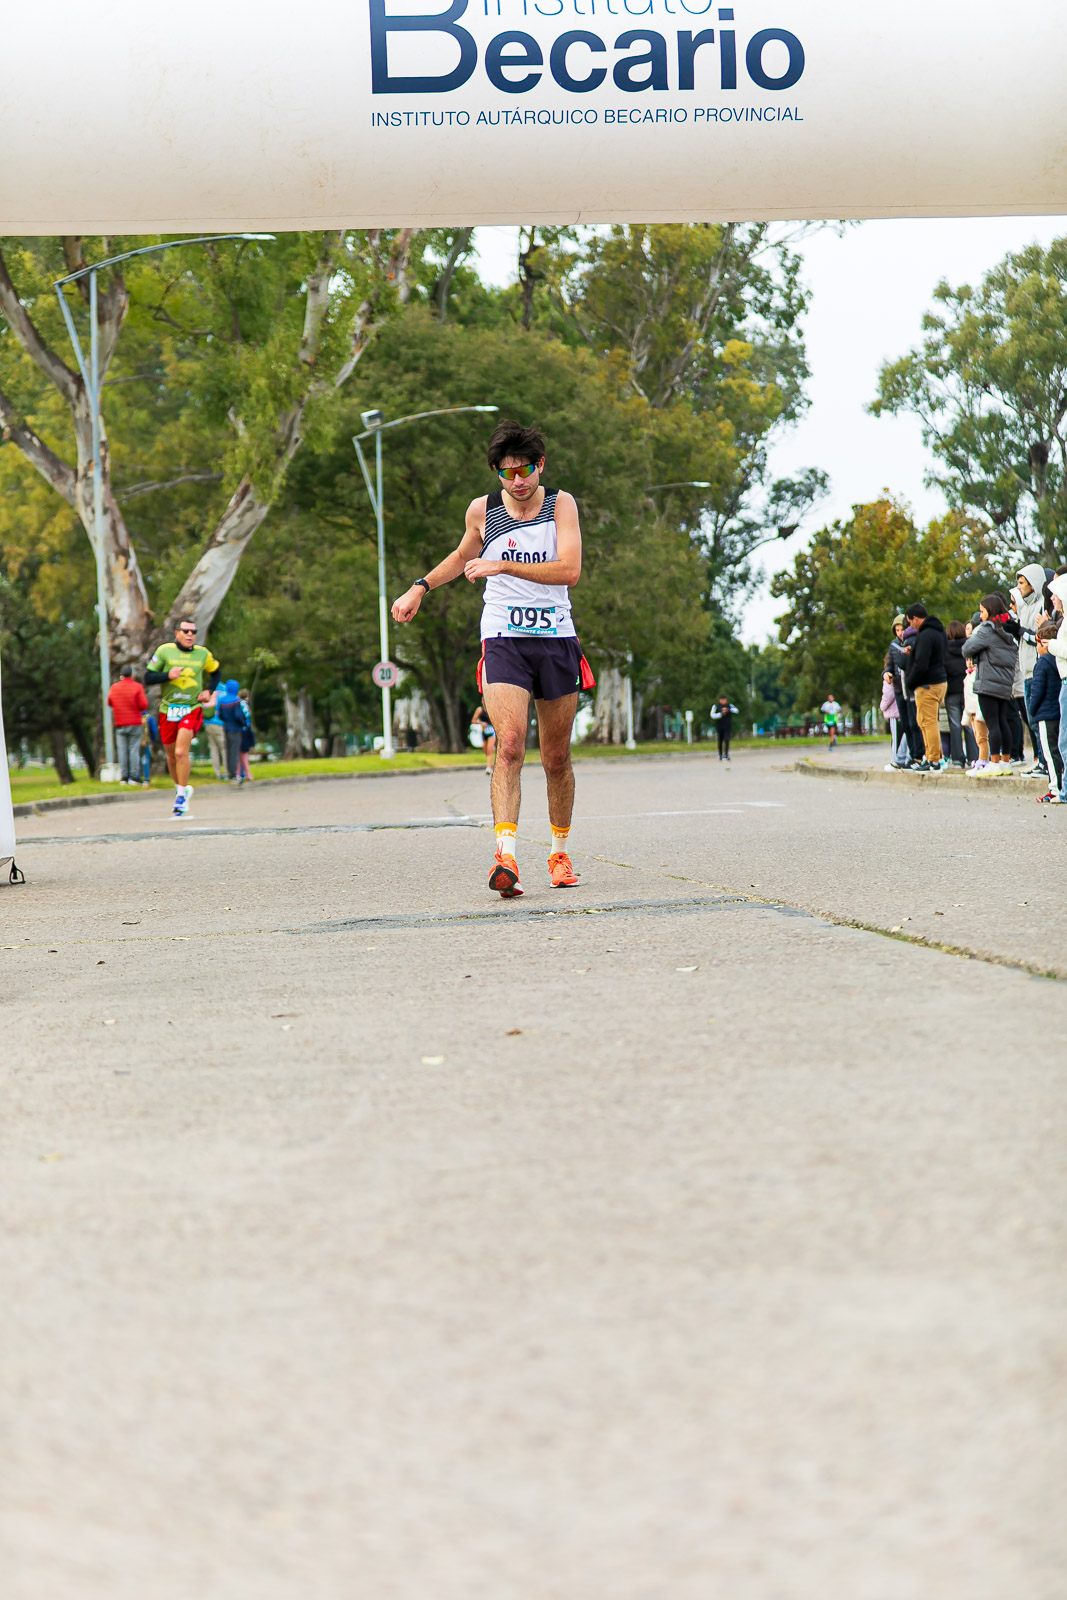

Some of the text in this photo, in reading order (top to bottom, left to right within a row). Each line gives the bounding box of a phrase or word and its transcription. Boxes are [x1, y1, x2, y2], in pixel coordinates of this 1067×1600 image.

[369, 0, 806, 94] Becario
[371, 106, 804, 127] INSTITUTO AUTÁRQUICO BECARIO PROVINCIAL
[510, 606, 552, 629] 095
[379, 667, 392, 680] 20
